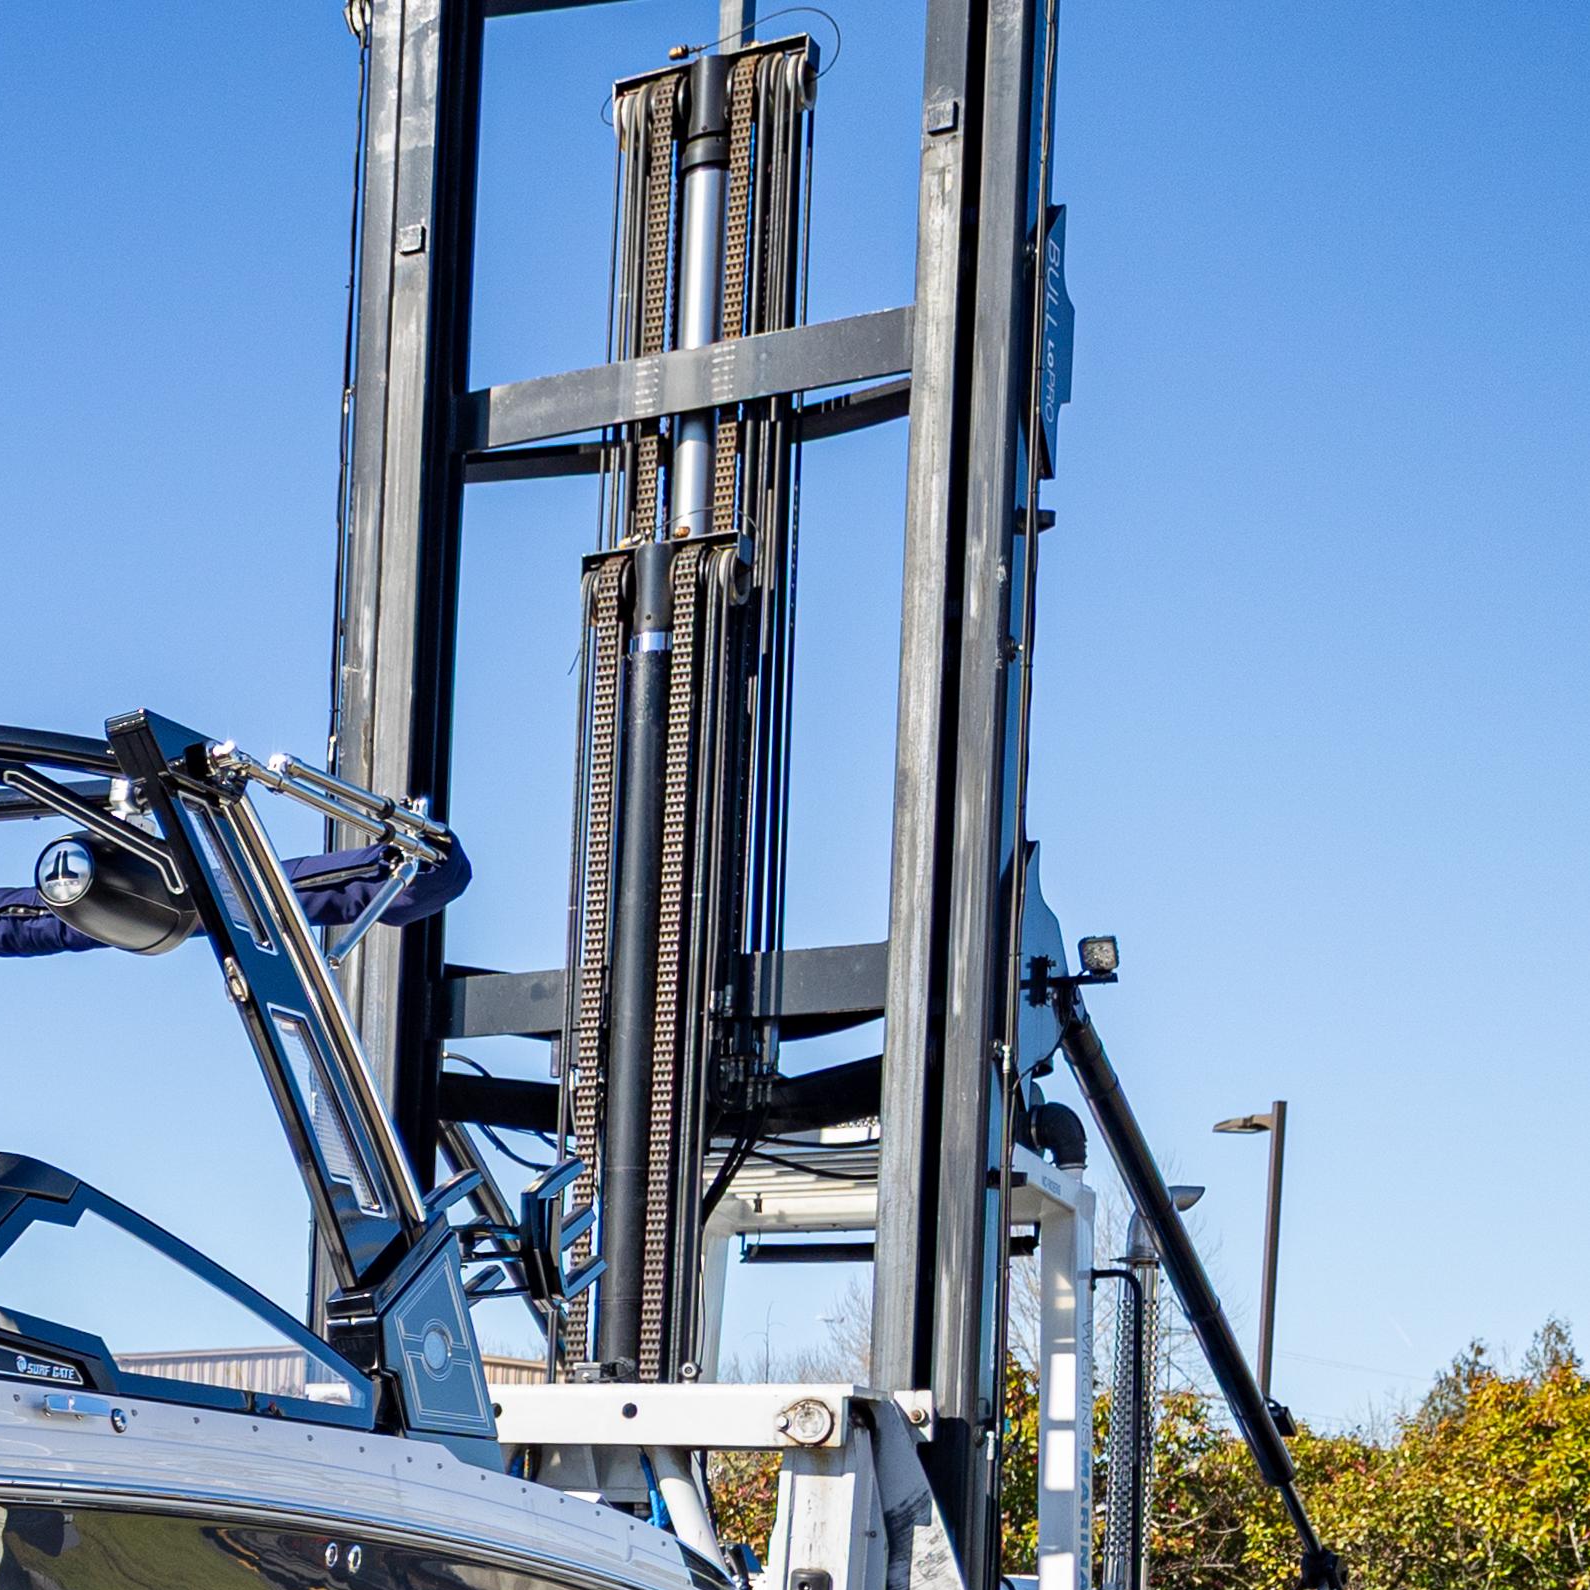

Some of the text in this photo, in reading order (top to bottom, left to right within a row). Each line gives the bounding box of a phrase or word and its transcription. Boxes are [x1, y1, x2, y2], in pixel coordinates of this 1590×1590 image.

[1044, 238, 1061, 333] BULL
[26, 1362, 75, 1380] SURF GATE
[1081, 1318, 1094, 1447] WIGGINS
